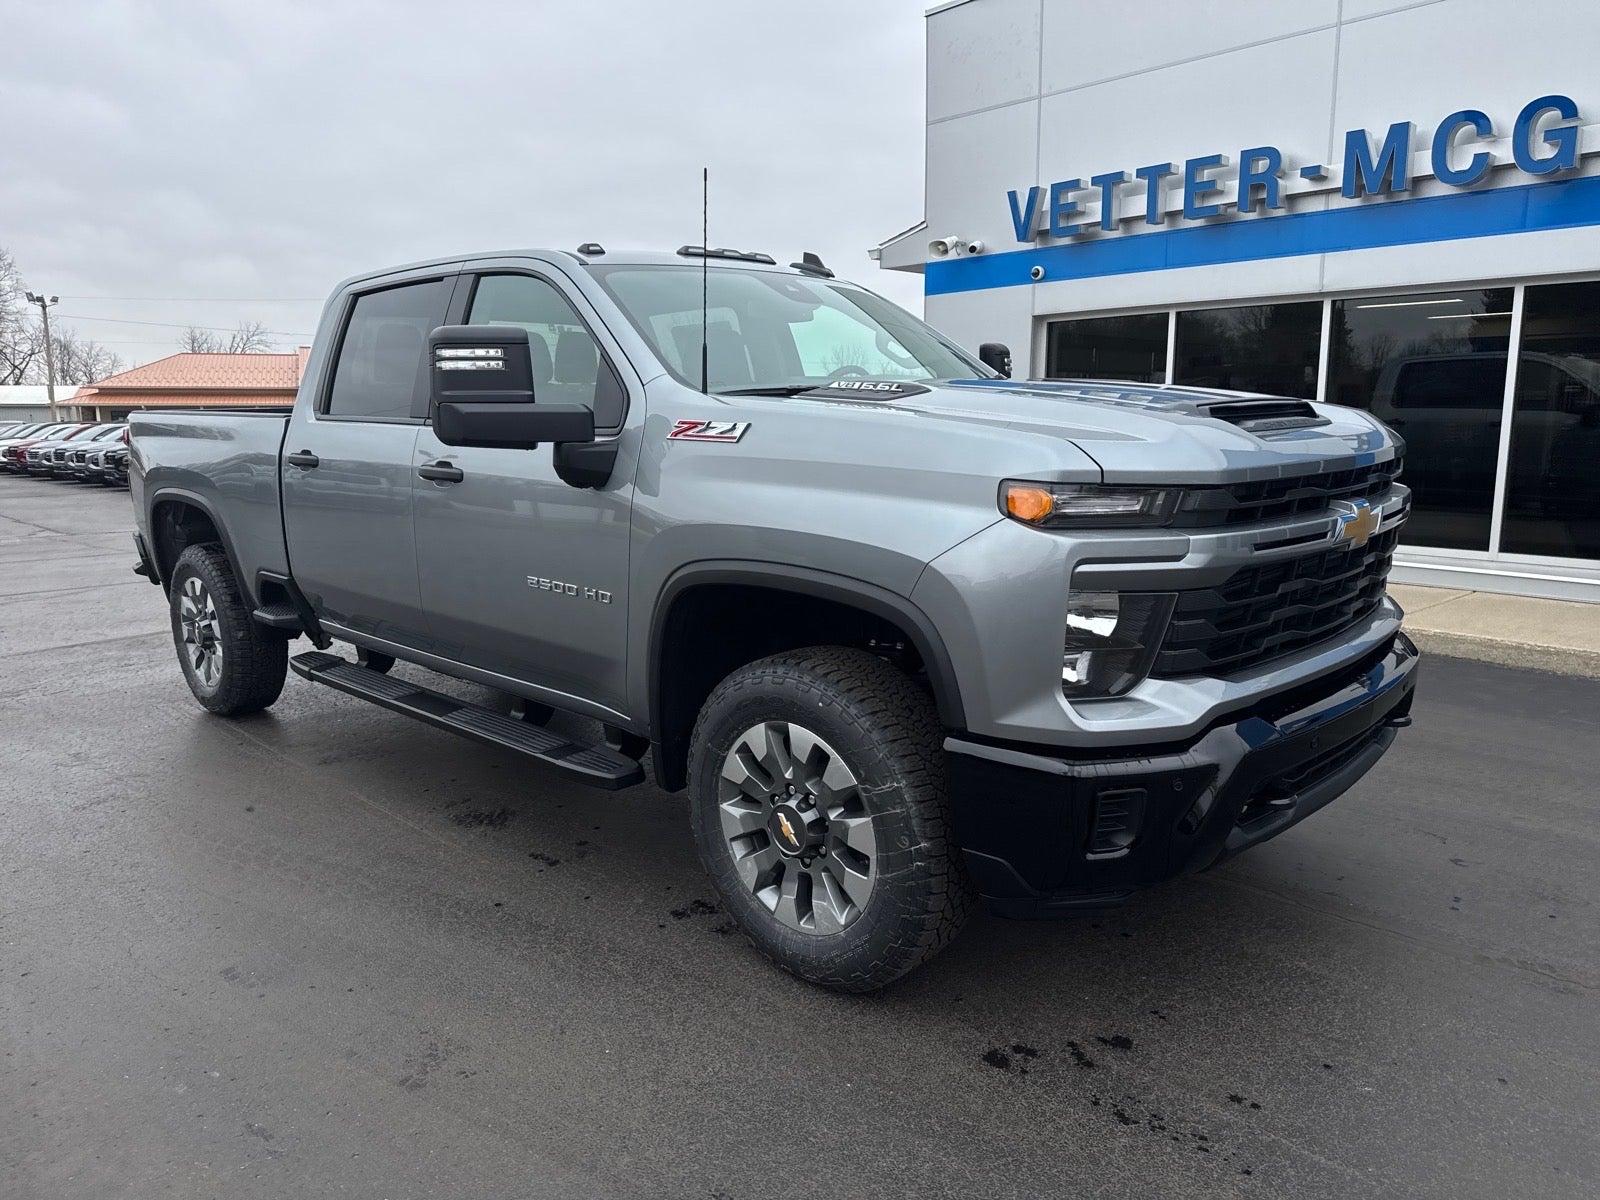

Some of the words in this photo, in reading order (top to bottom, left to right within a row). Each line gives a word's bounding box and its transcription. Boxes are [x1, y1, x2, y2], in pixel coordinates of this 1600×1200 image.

[1007, 95, 1582, 242] VETTER-MCG
[666, 420, 752, 443] Z71
[527, 575, 578, 596] 2500
[584, 587, 612, 604] HD
